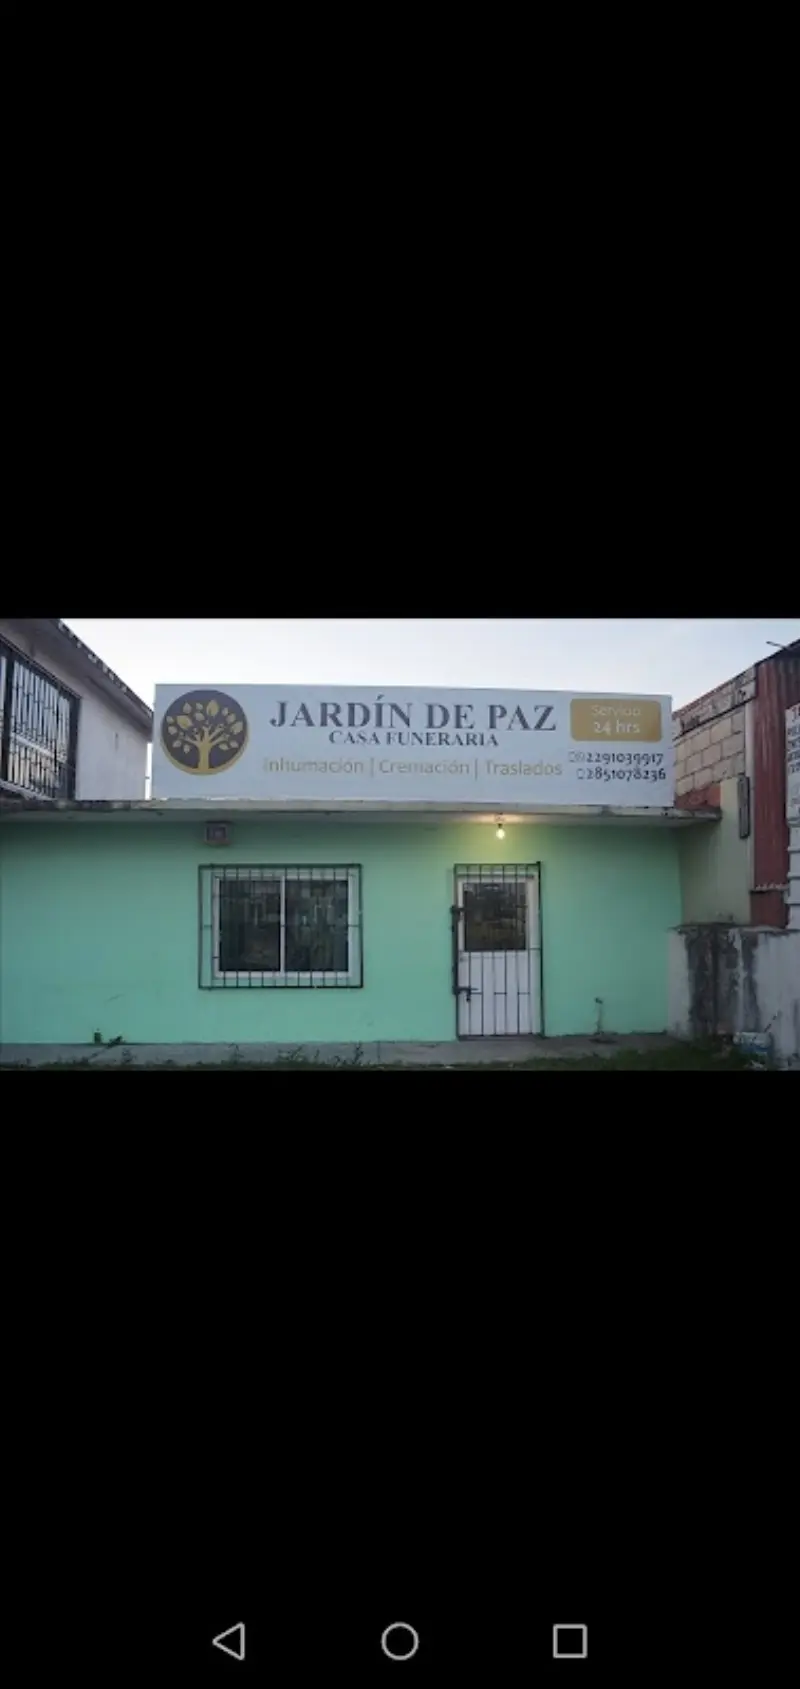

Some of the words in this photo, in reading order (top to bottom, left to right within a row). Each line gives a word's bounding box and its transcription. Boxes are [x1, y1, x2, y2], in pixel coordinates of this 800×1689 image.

[269, 695, 413, 728] JARDÍN
[426, 702, 475, 729] DE
[488, 703, 557, 731] PAZ
[594, 721, 611, 736] 24
[616, 719, 640, 733] hrs
[329, 730, 381, 746] CASA
[386, 731, 499, 747] FUNERARIA
[263, 757, 364, 774] Inhumación
[379, 757, 470, 775] Cremación
[484, 758, 563, 776] Traslados
[586, 752, 664, 767] 2291039917
[586, 766, 666, 782] 2851078236
